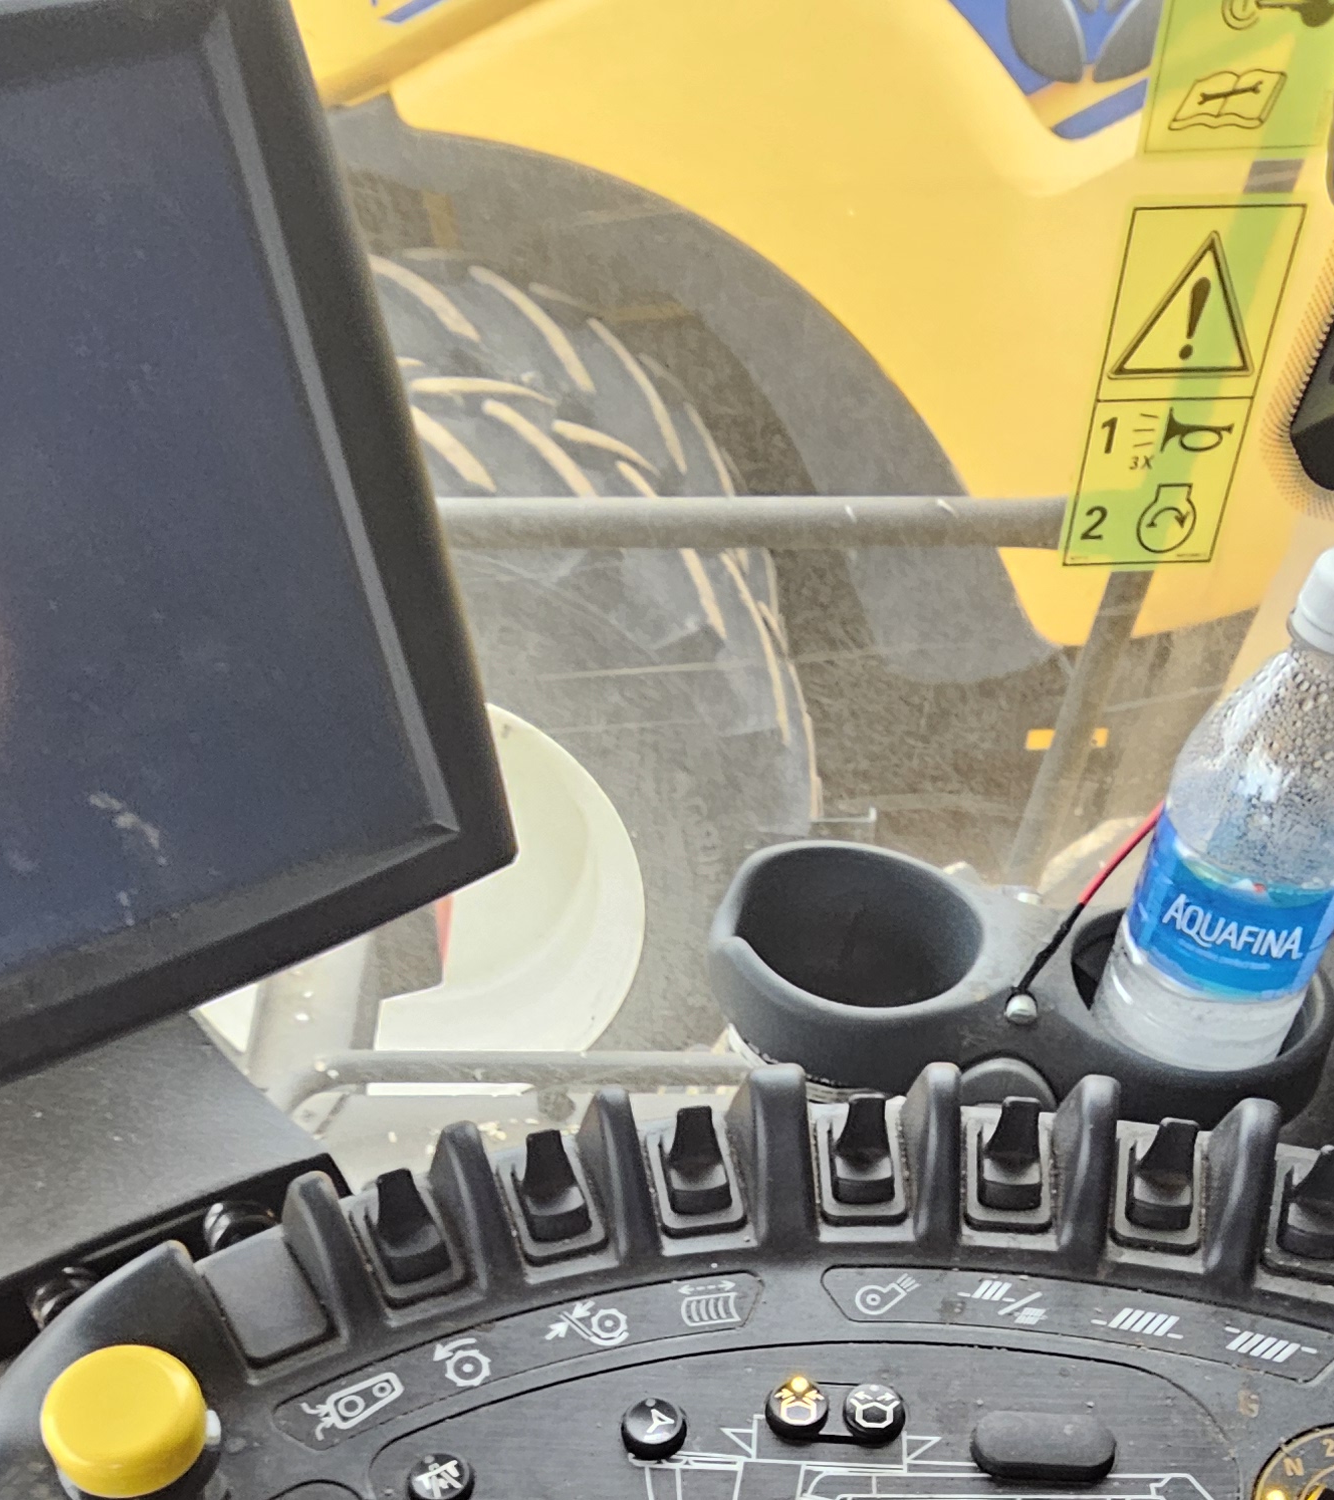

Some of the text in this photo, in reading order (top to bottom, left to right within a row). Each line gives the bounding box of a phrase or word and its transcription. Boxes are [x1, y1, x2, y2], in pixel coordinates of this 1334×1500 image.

[1101, 417, 1117, 454] 1
[1080, 505, 1108, 540] 2
[1162, 893, 1304, 960] AQUAFINA
[1283, 1457, 1304, 1476] N
